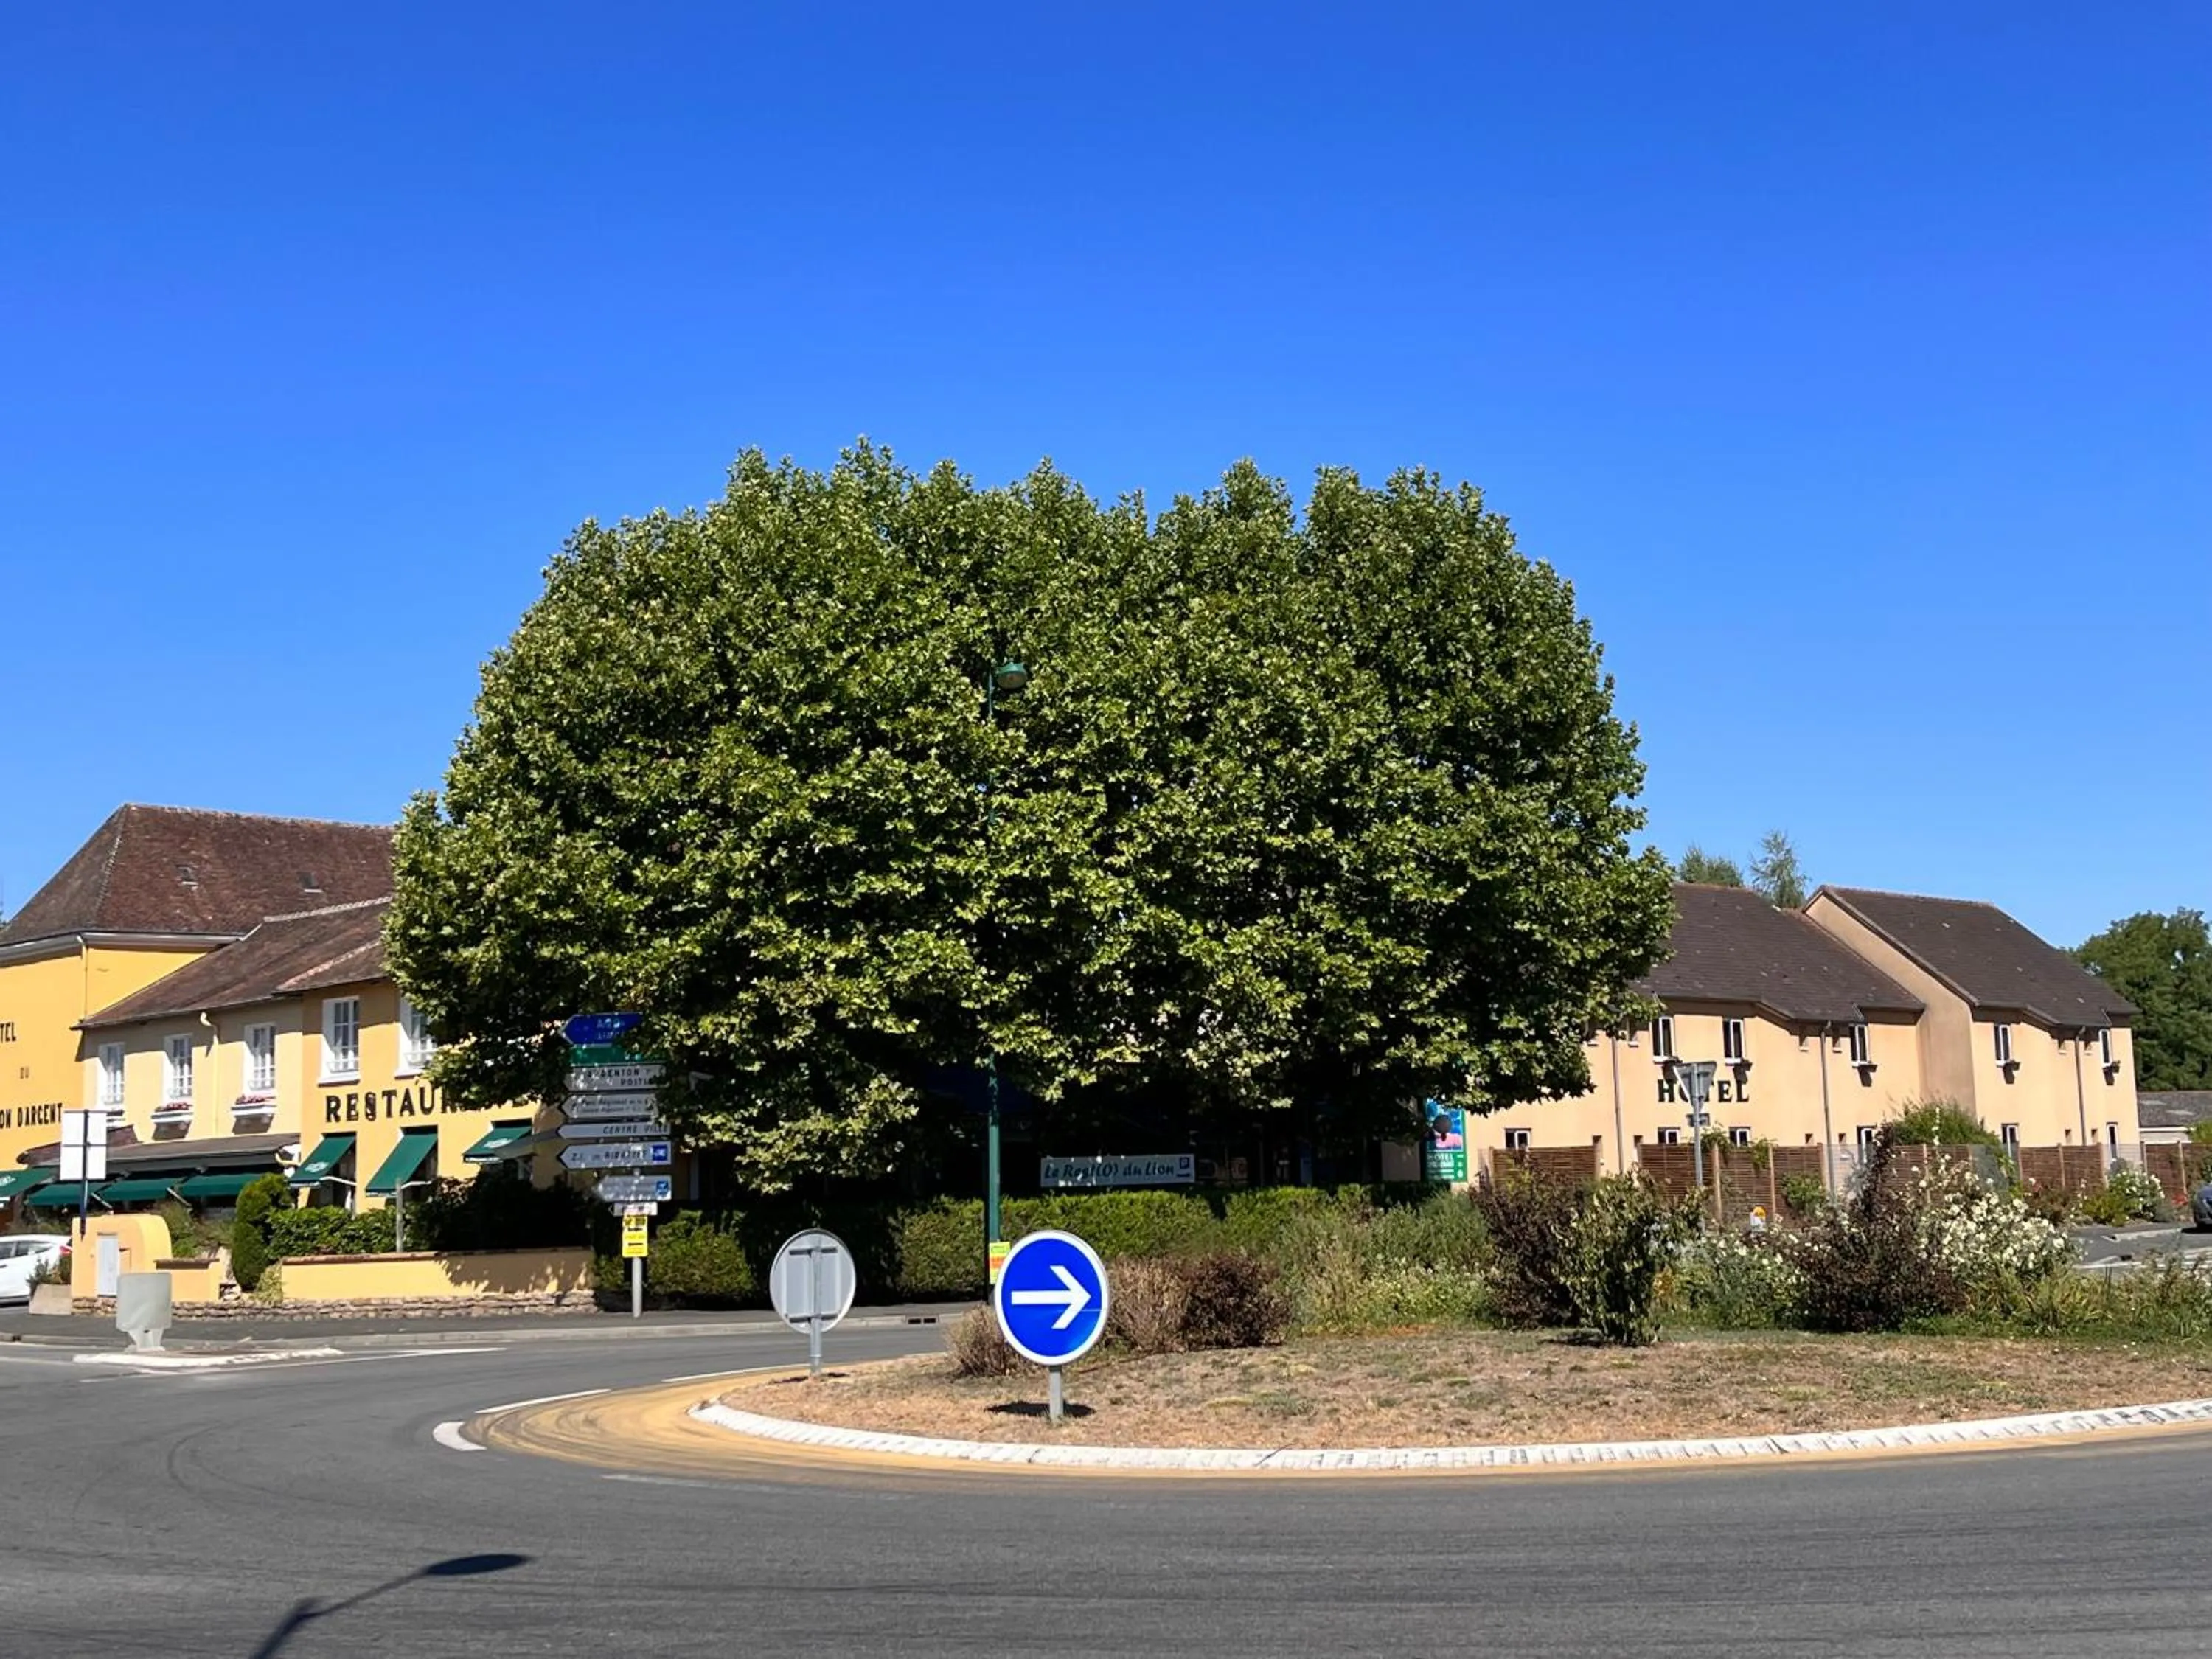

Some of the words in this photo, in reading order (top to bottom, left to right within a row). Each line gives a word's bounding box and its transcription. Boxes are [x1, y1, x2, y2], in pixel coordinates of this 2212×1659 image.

[1658, 1079, 1750, 1102] HEL
[602, 1125, 638, 1135] CENTRE
[644, 1124, 667, 1134] VILLE
[1044, 1162, 1059, 1178] Le
[1123, 1162, 1142, 1176] du
[1145, 1161, 1175, 1176] Lion
